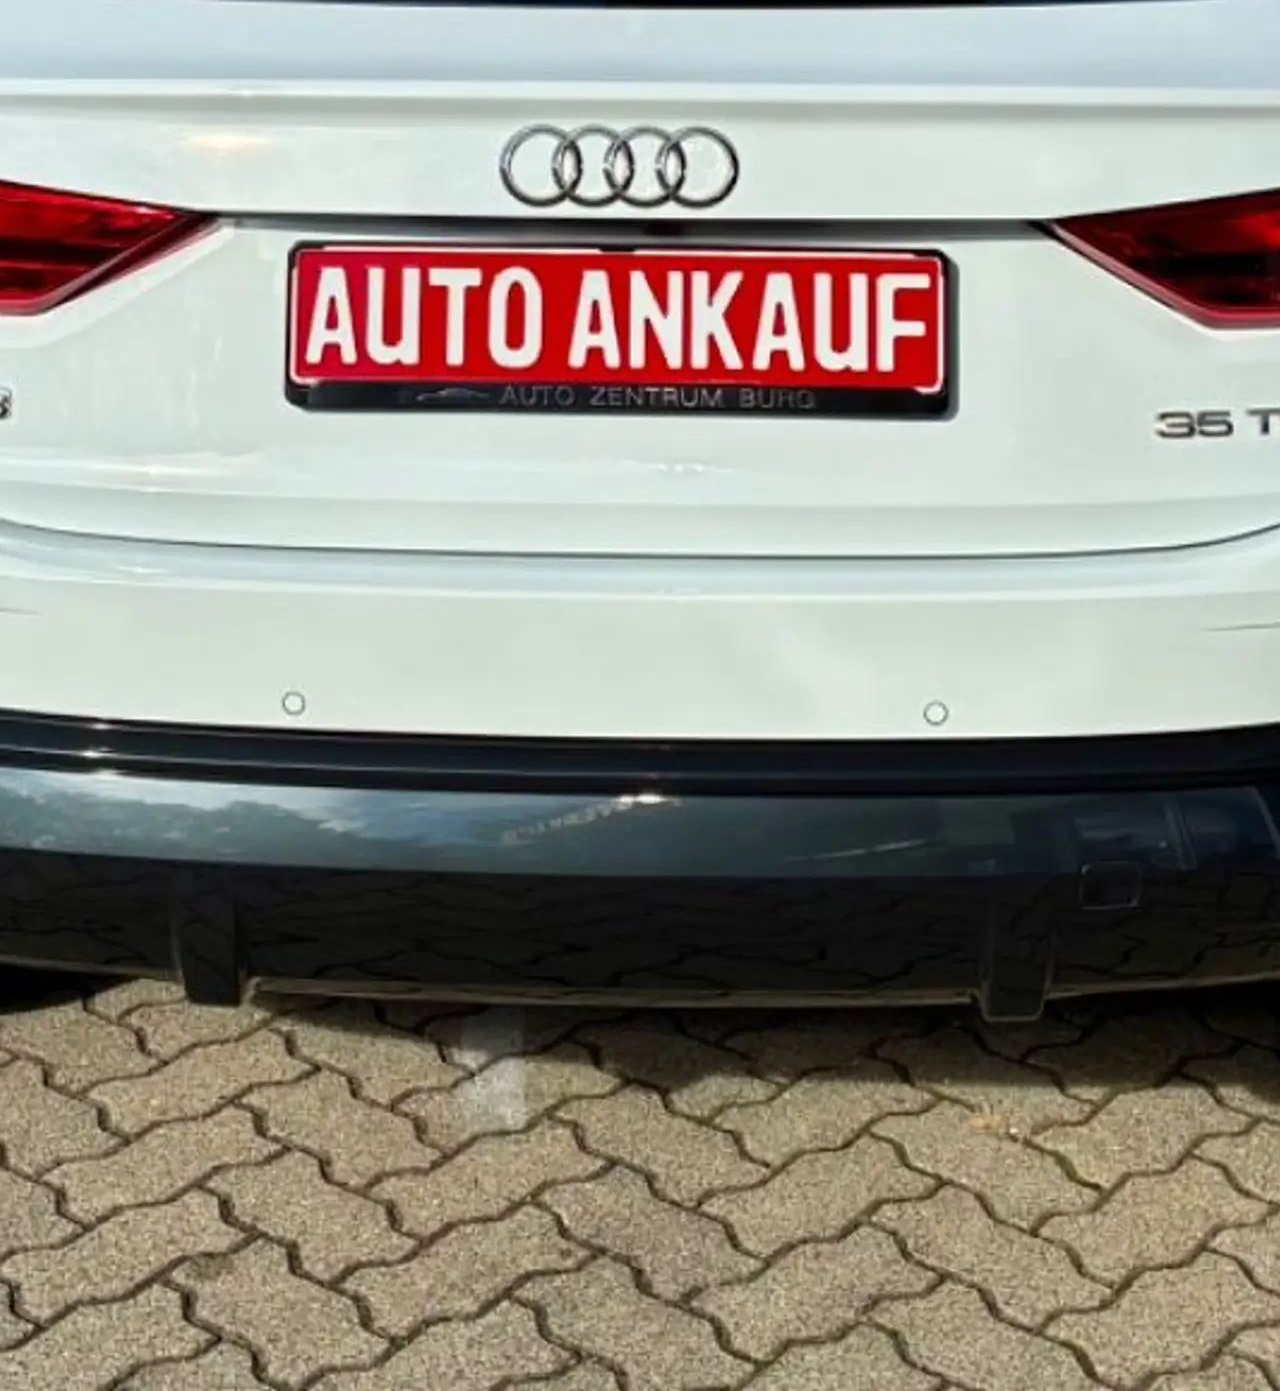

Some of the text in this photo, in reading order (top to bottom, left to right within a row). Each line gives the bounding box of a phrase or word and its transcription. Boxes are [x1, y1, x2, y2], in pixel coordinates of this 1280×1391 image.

[304, 265, 932, 372] AUTO ANKAUF
[498, 384, 816, 409] AUTO ZENTRUM BURG
[1155, 410, 1234, 439] 35
